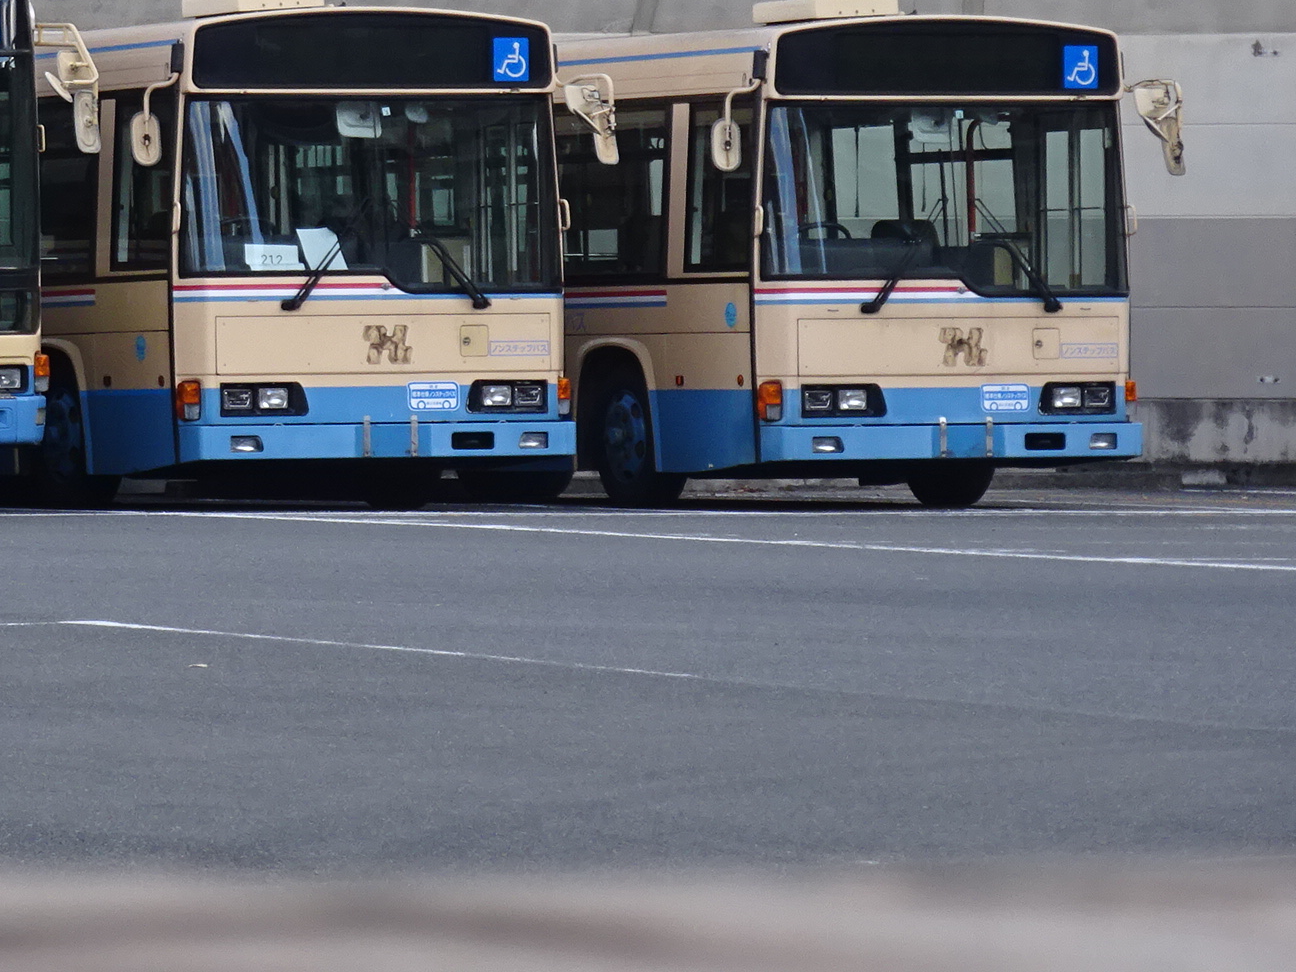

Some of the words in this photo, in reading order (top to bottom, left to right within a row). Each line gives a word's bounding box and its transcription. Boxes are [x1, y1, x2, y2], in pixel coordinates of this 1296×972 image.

[261, 254, 283, 265] 212
[492, 343, 548, 353] ノンステップバス
